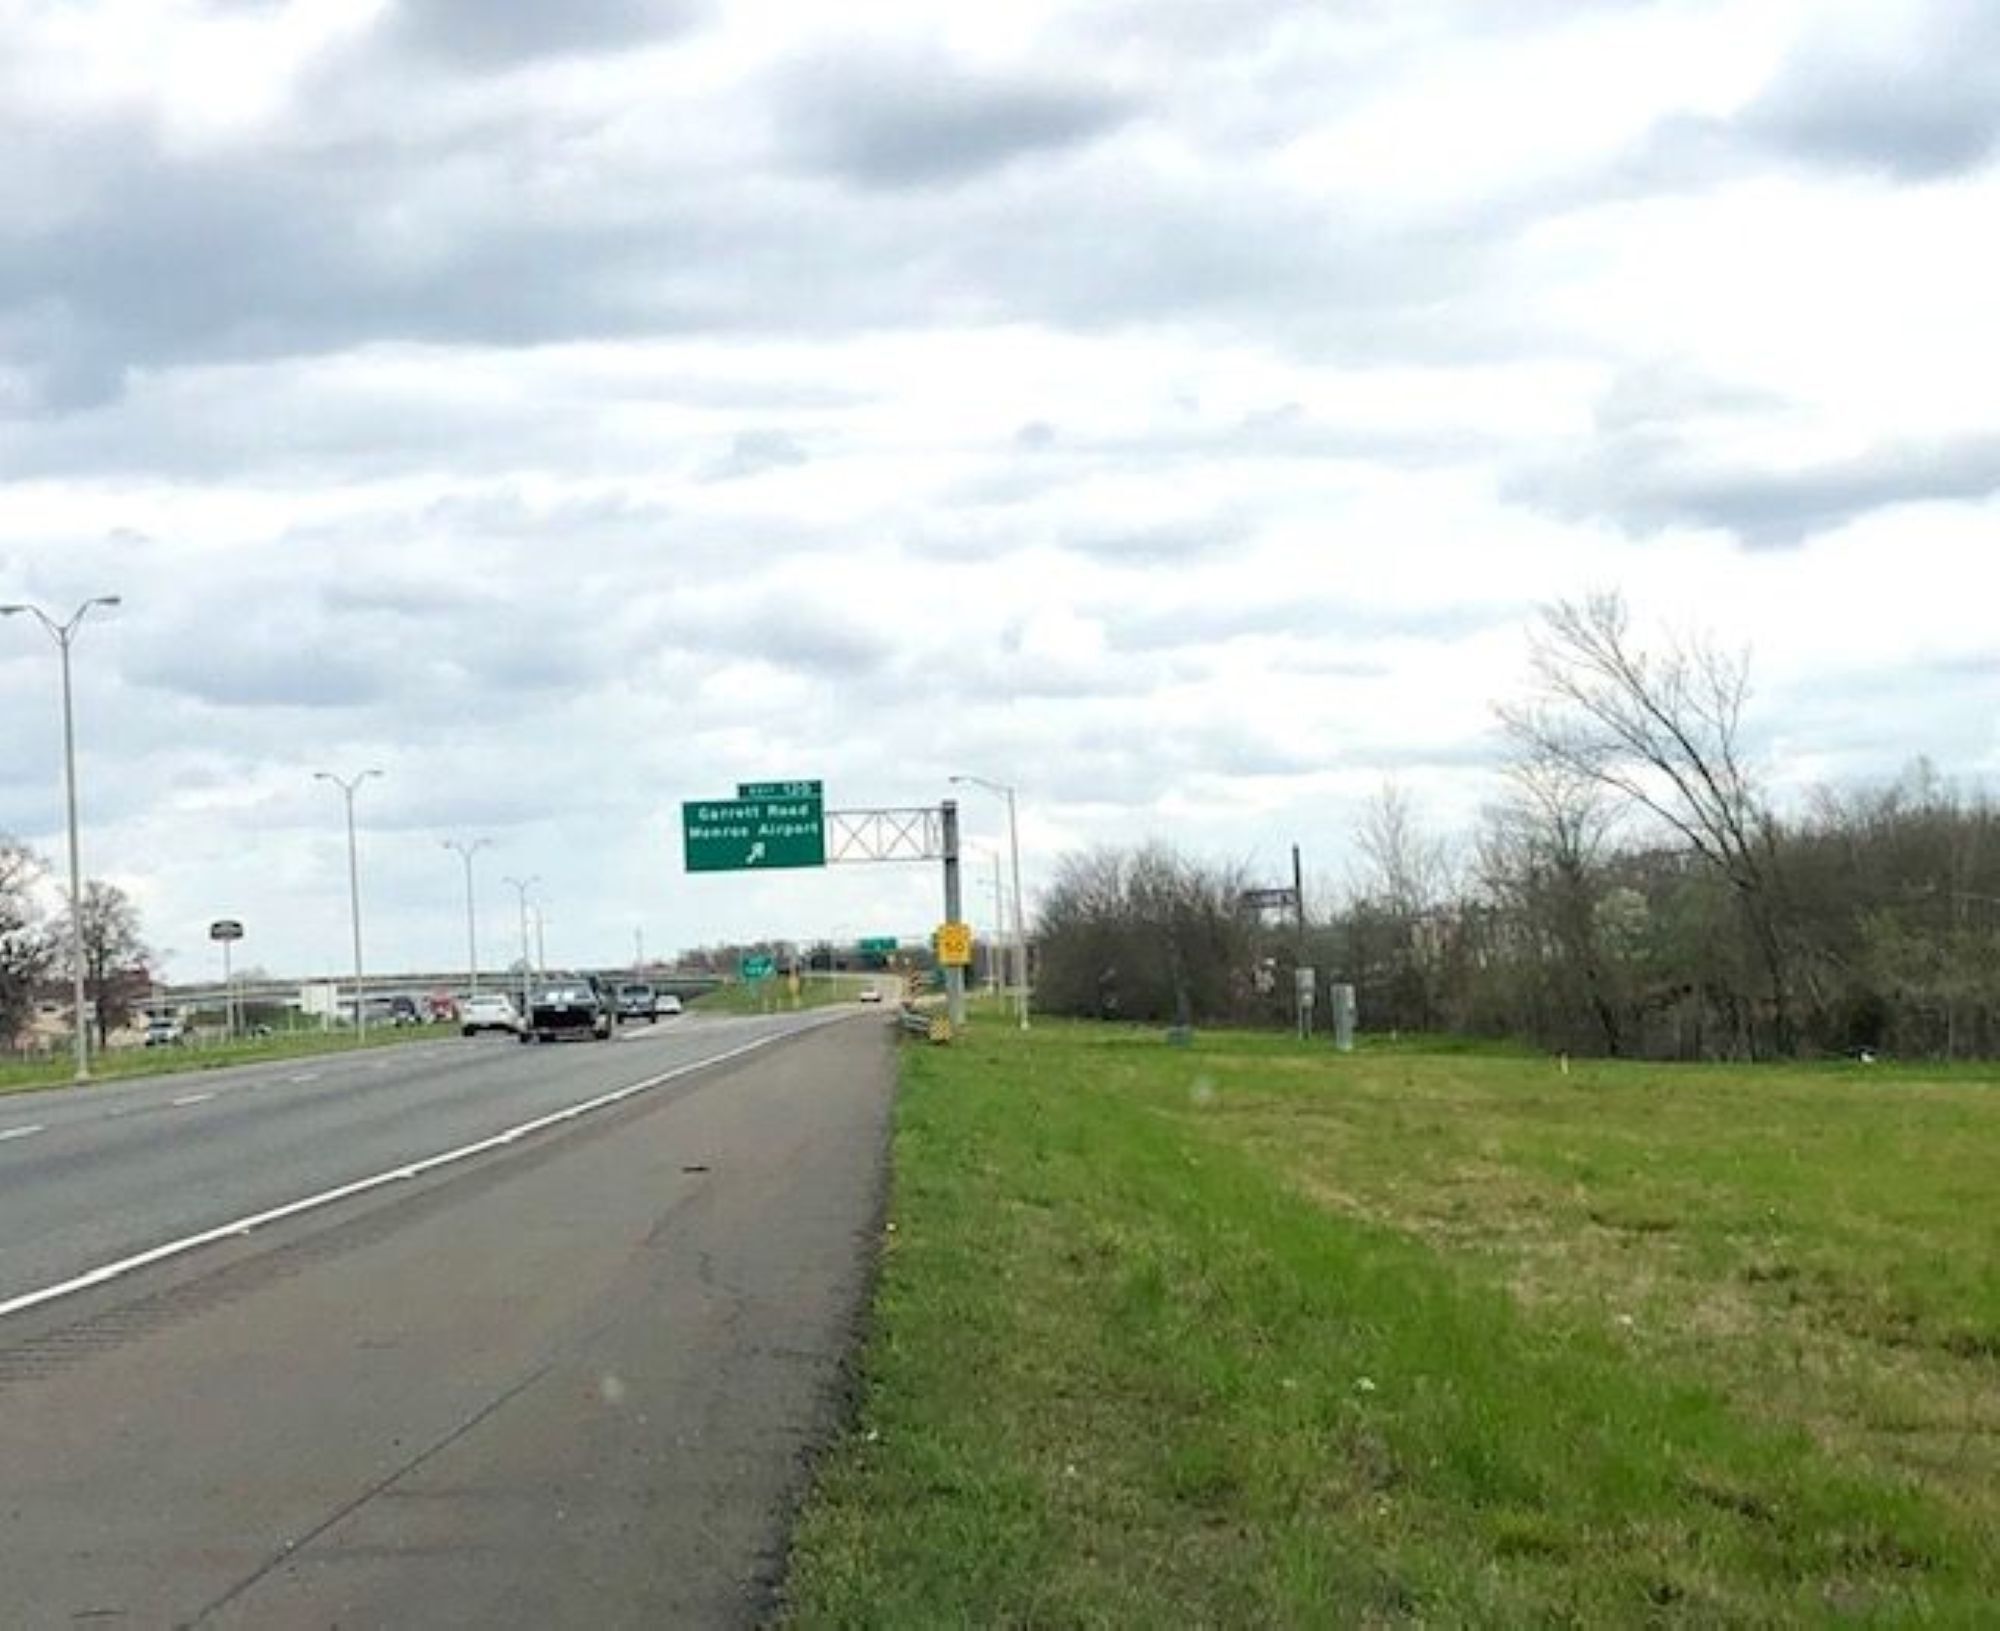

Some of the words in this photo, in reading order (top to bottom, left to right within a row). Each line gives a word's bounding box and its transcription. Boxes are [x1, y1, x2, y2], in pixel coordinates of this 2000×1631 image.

[698, 805, 759, 821] Garrett
[767, 804, 809, 818] Road
[689, 826, 749, 839] Monroe
[758, 823, 818, 837] Airport
